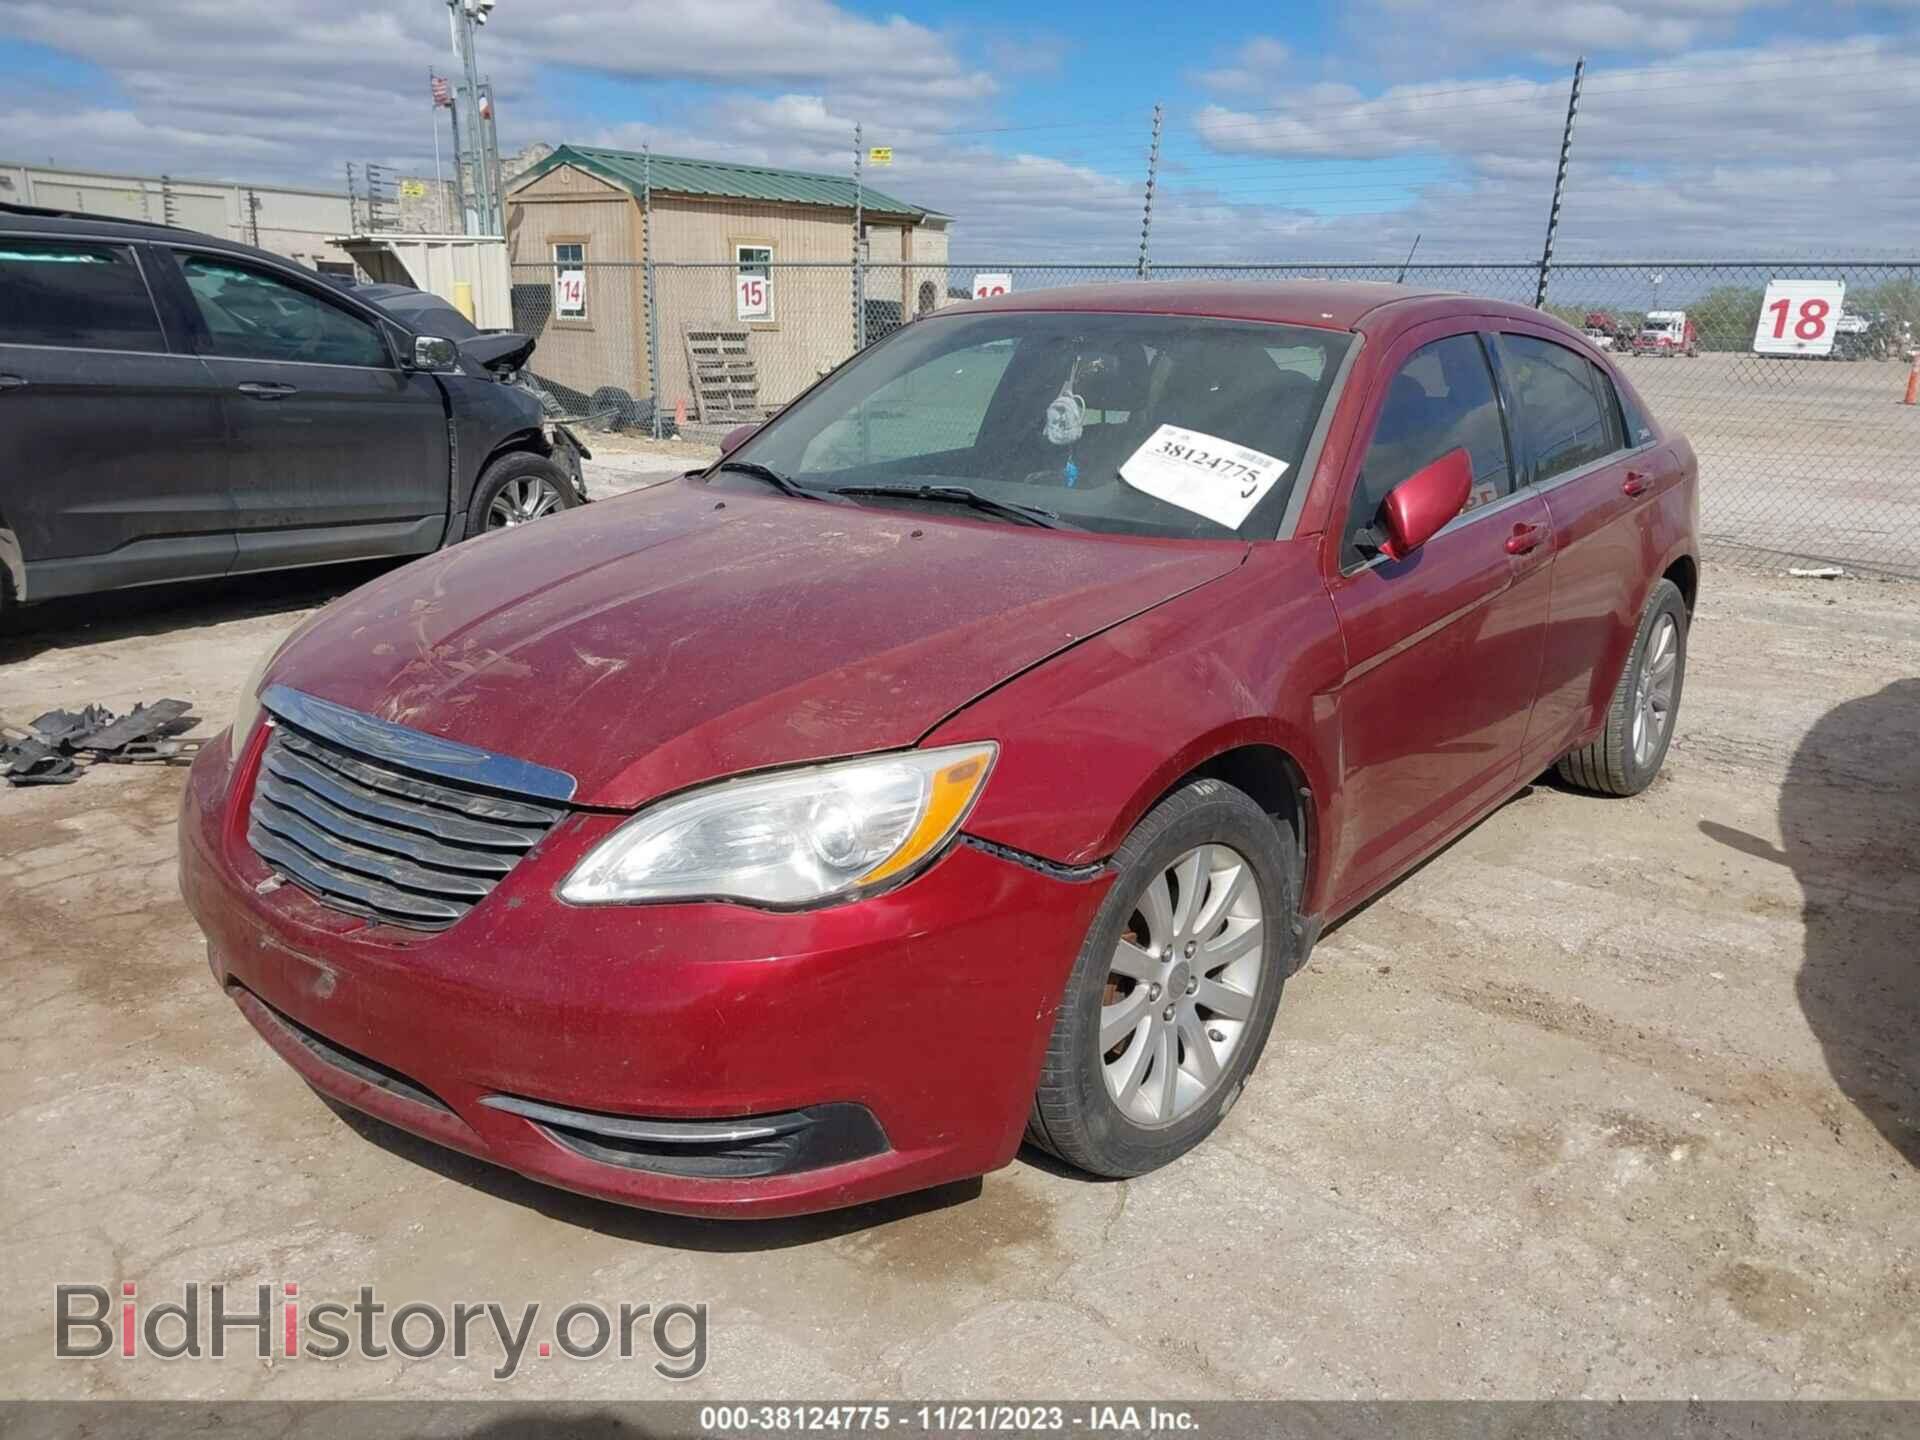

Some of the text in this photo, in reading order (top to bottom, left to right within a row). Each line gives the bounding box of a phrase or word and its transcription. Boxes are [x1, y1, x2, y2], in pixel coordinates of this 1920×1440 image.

[564, 280, 580, 302] 14
[741, 281, 762, 306] 15
[1769, 298, 1830, 340] 18
[1155, 441, 1261, 483] 38124775
